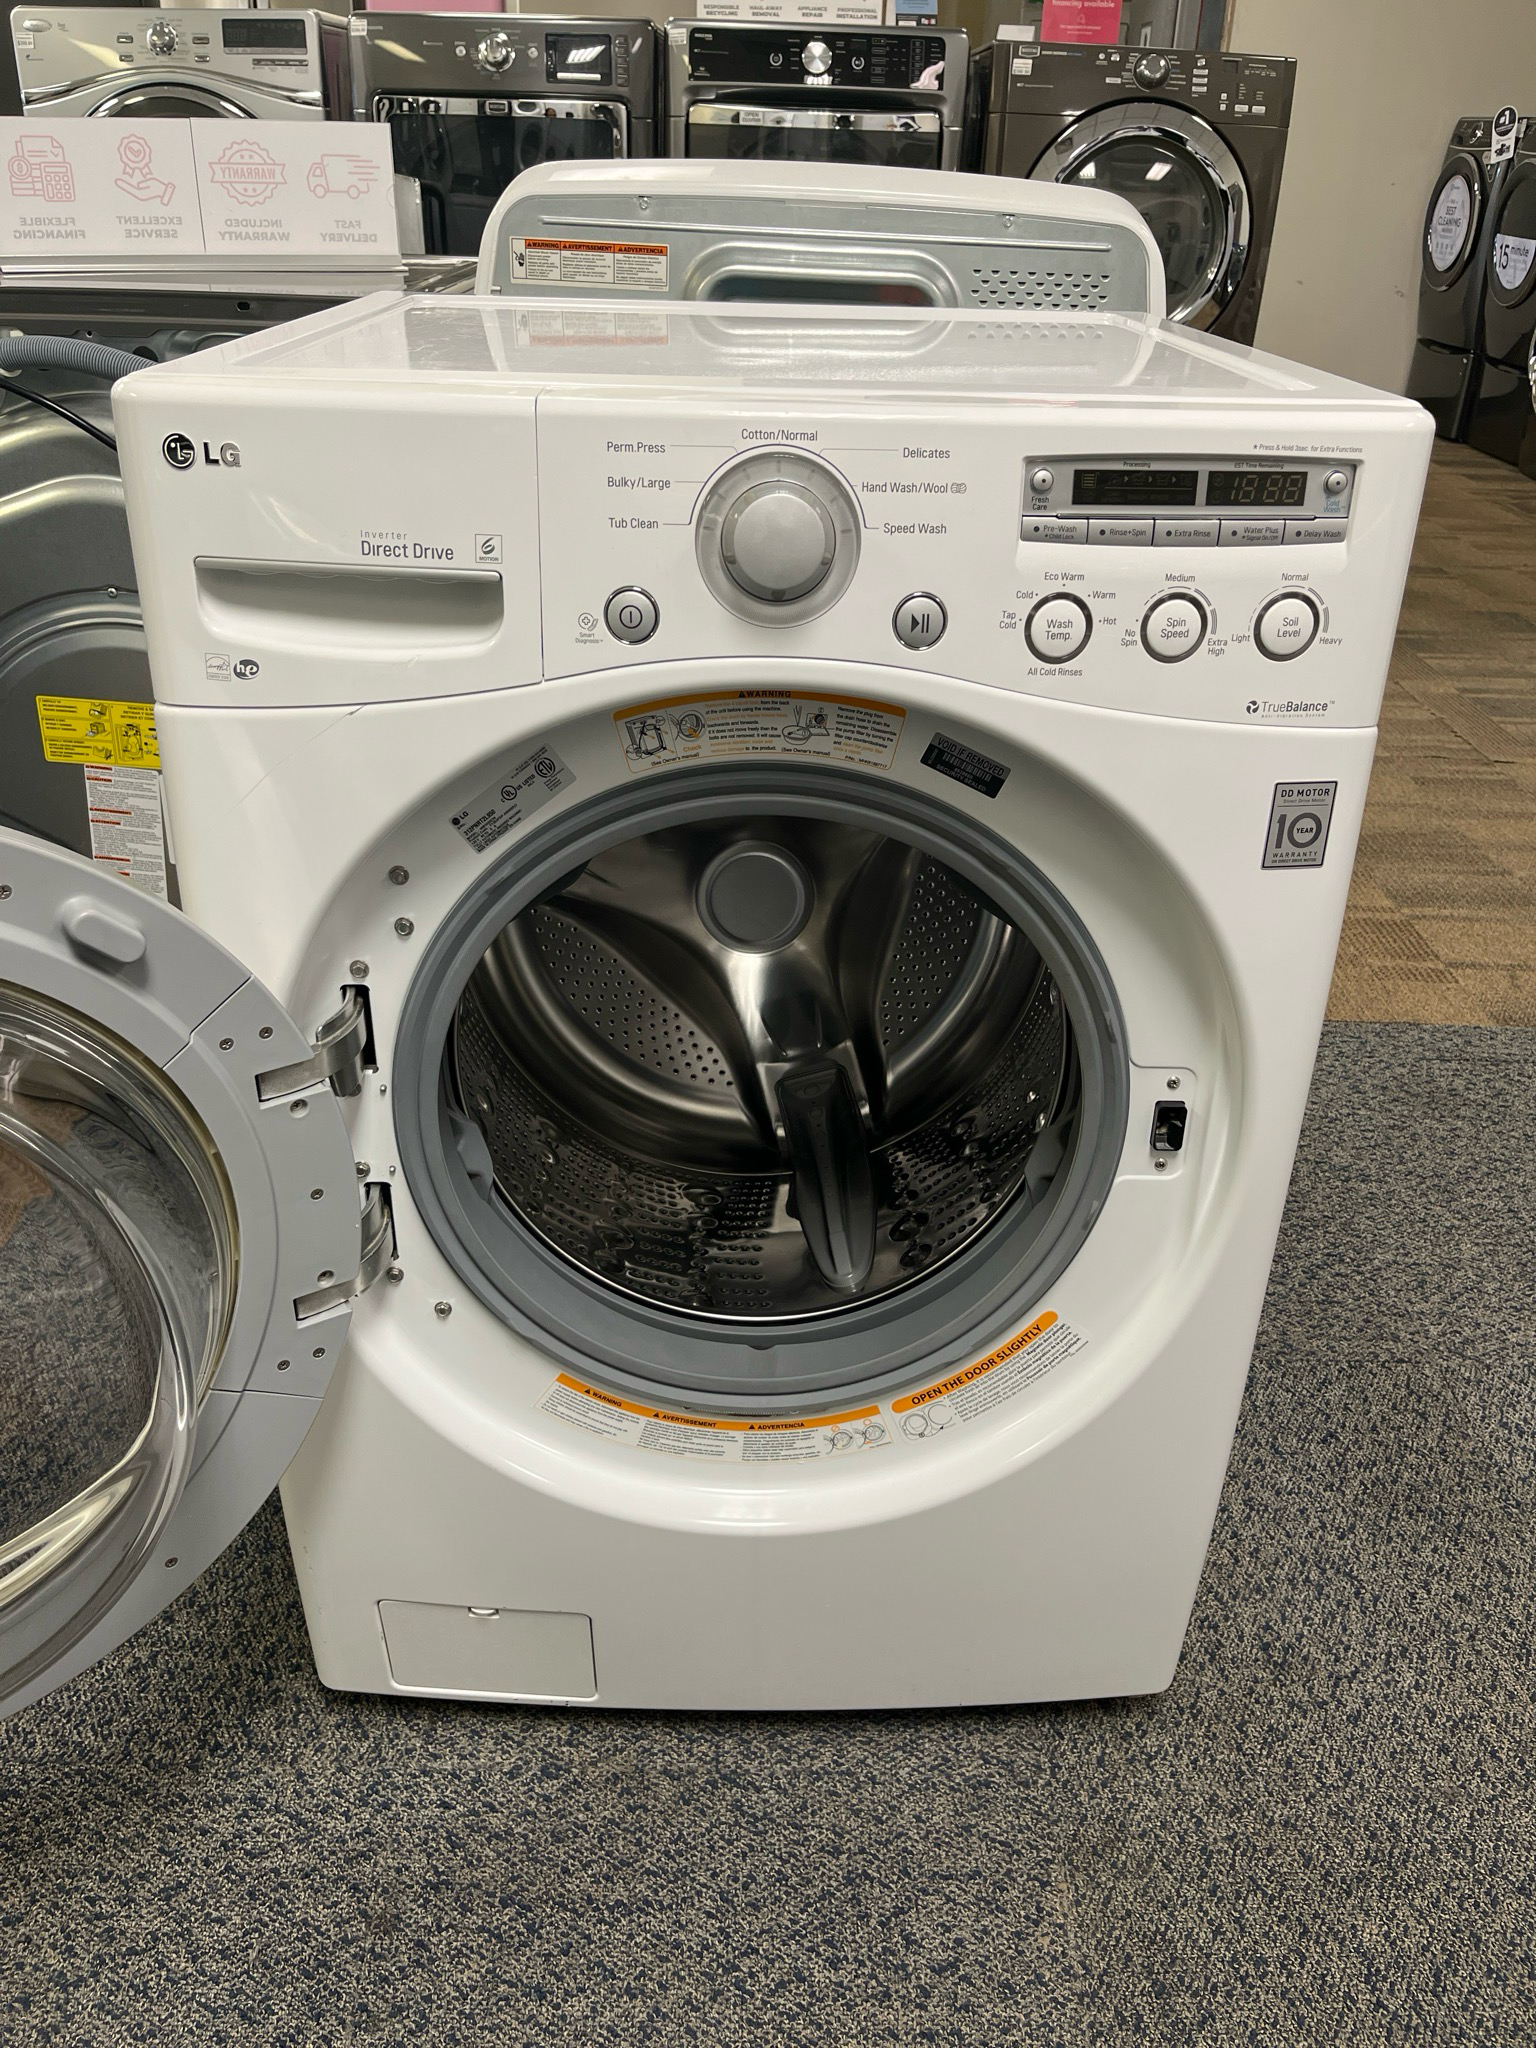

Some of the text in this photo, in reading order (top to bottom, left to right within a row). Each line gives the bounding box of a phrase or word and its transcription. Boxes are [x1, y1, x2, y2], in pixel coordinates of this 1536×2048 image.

[1438, 216, 1462, 228] CLEANING
[623, 246, 664, 254] ADVERTENCIA
[1499, 243, 1510, 270] 15
[1510, 246, 1530, 258] minute
[741, 429, 818, 442] Cotton/Normal
[606, 442, 666, 454] Perm.Press
[902, 447, 950, 459] Delicates
[204, 441, 242, 468] LG
[607, 476, 671, 490] Bulky/Large
[862, 482, 948, 494] Hand Wash/Wool
[608, 518, 659, 530] Tub Clean
[883, 522, 948, 536] Speed Wash
[1044, 525, 1077, 533] Pre-Wash
[360, 530, 408, 540] Inverter
[1110, 529, 1146, 538] Rinse+Spin
[1304, 530, 1322, 538] Delay
[361, 540, 454, 561] Direct Drive
[1044, 572, 1084, 580] Eco Warm
[1165, 574, 1196, 582] Medium
[1282, 572, 1309, 581] Normal
[1016, 590, 1034, 599] Cold
[1092, 591, 1116, 599] Warm
[1002, 611, 1016, 620] Tap
[1000, 621, 1016, 630] Cold
[1046, 619, 1073, 628] Wash
[1103, 617, 1116, 626] Hot
[1166, 618, 1186, 628] Spin
[1282, 617, 1298, 626] Soil
[1045, 631, 1072, 642] Temp.
[1125, 629, 1136, 637] No
[1160, 629, 1190, 640] Speed
[1232, 634, 1250, 642] Light
[1276, 628, 1301, 638] Level
[1120, 638, 1138, 647] Spin
[1208, 638, 1228, 646] Extra
[1319, 638, 1342, 646] Heavy
[1208, 648, 1224, 656] High
[1027, 668, 1082, 677] All Cold Rinses
[937, 738, 957, 752] VOID
[966, 752, 1004, 777] REMOVED
[522, 774, 536, 786] LISTED
[1281, 788, 1330, 798] DD MOTOR
[458, 811, 469, 820] LG
[1275, 812, 1322, 848] 10
[911, 1324, 1042, 1405] OPEN THE DOOR SLIGHTLY
[592, 1391, 622, 1407] WARNING
[662, 1414, 716, 1428] AVERTISSEMENT
